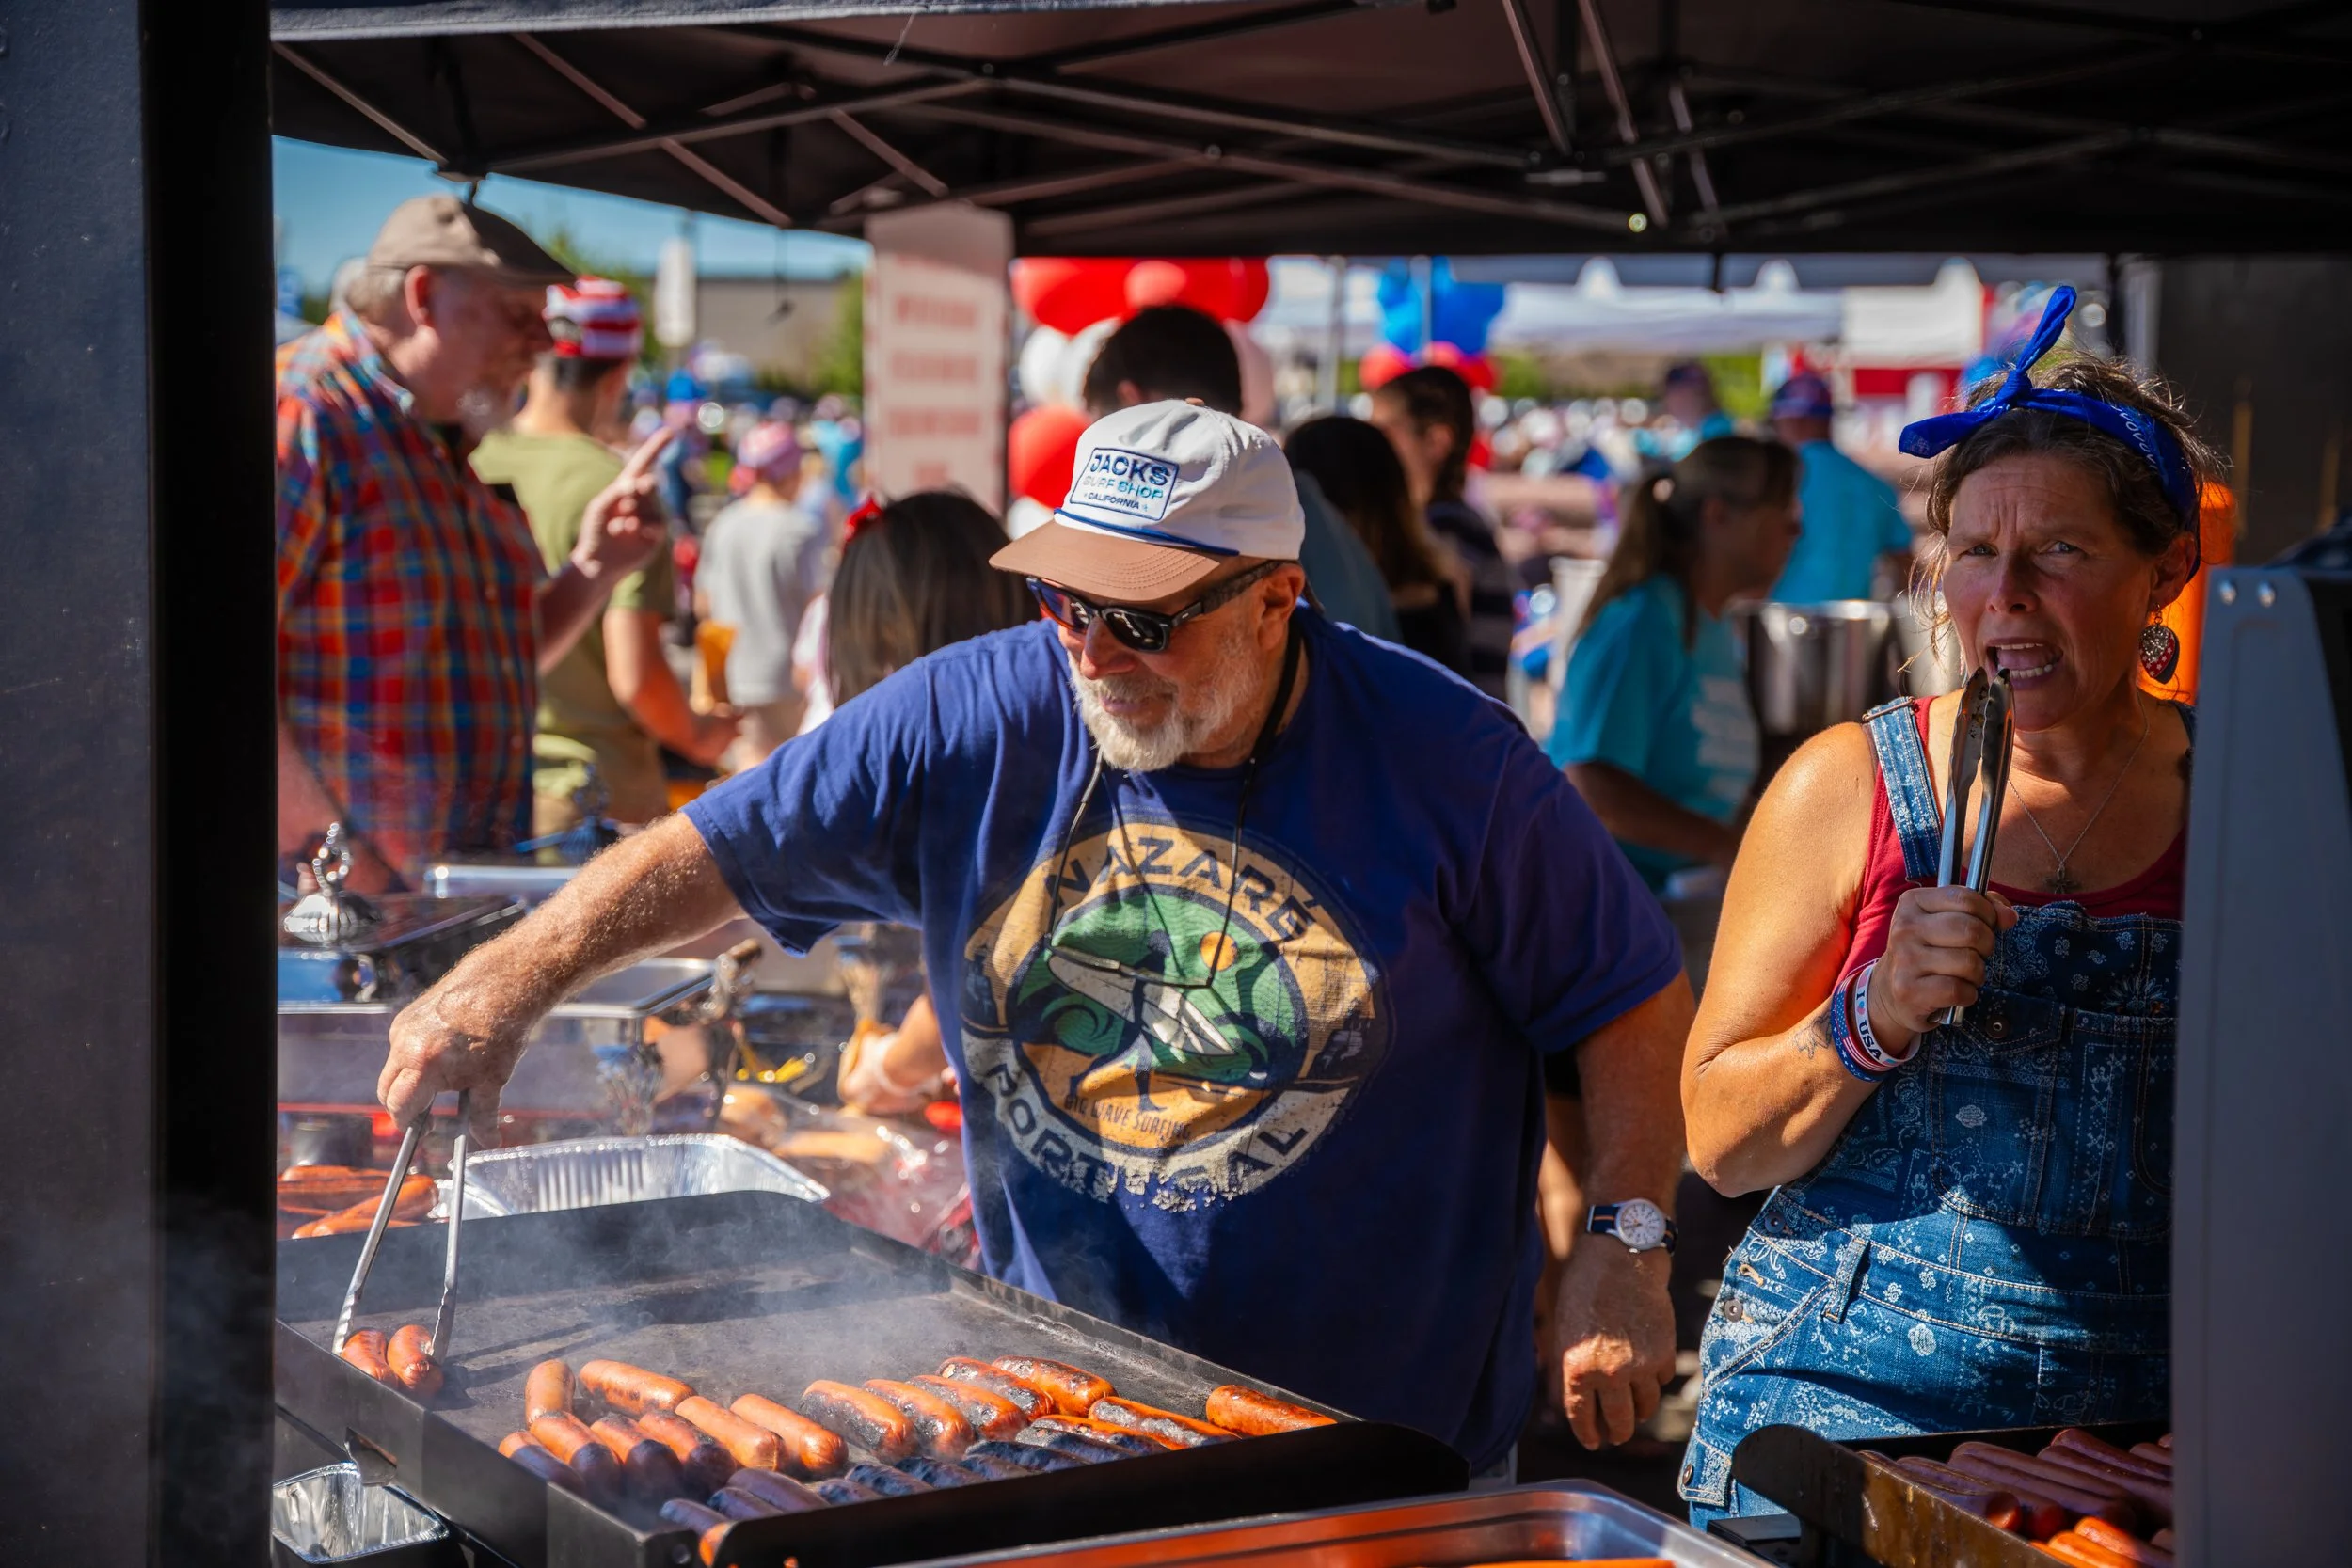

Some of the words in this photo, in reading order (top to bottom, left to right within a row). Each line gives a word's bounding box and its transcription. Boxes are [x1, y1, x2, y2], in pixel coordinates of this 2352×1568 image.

[1090, 454, 1171, 486] JACKS
[1088, 492, 1140, 510] CALIFORNIA
[1117, 480, 1164, 499] SHOP
[1856, 990, 1866, 1000] I
[1859, 1020, 1883, 1060] USA
[1091, 1098, 1130, 1128] WAVE
[1132, 1111, 1192, 1141] SURFING
